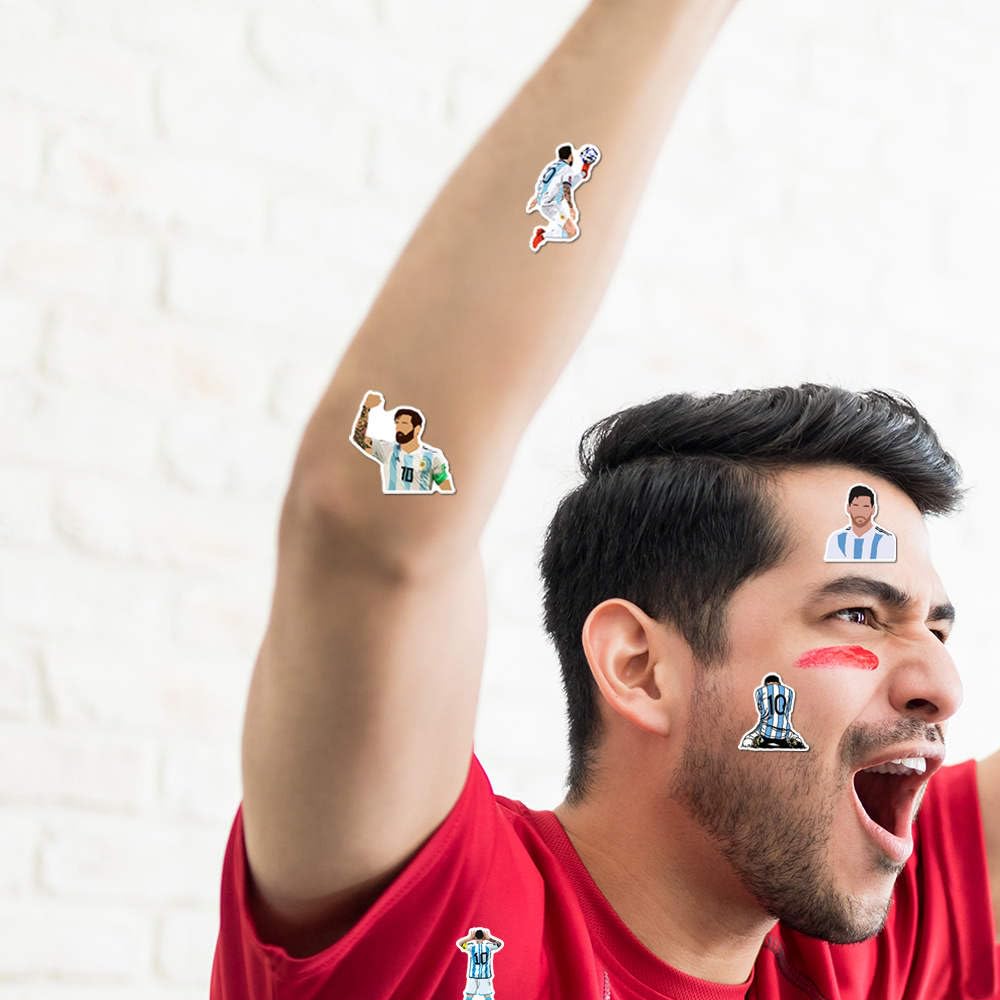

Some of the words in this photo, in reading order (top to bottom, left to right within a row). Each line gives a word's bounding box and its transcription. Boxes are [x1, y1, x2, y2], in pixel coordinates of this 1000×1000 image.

[401, 466, 414, 482] 10
[768, 694, 786, 715] 10
[474, 952, 488, 965] 10
